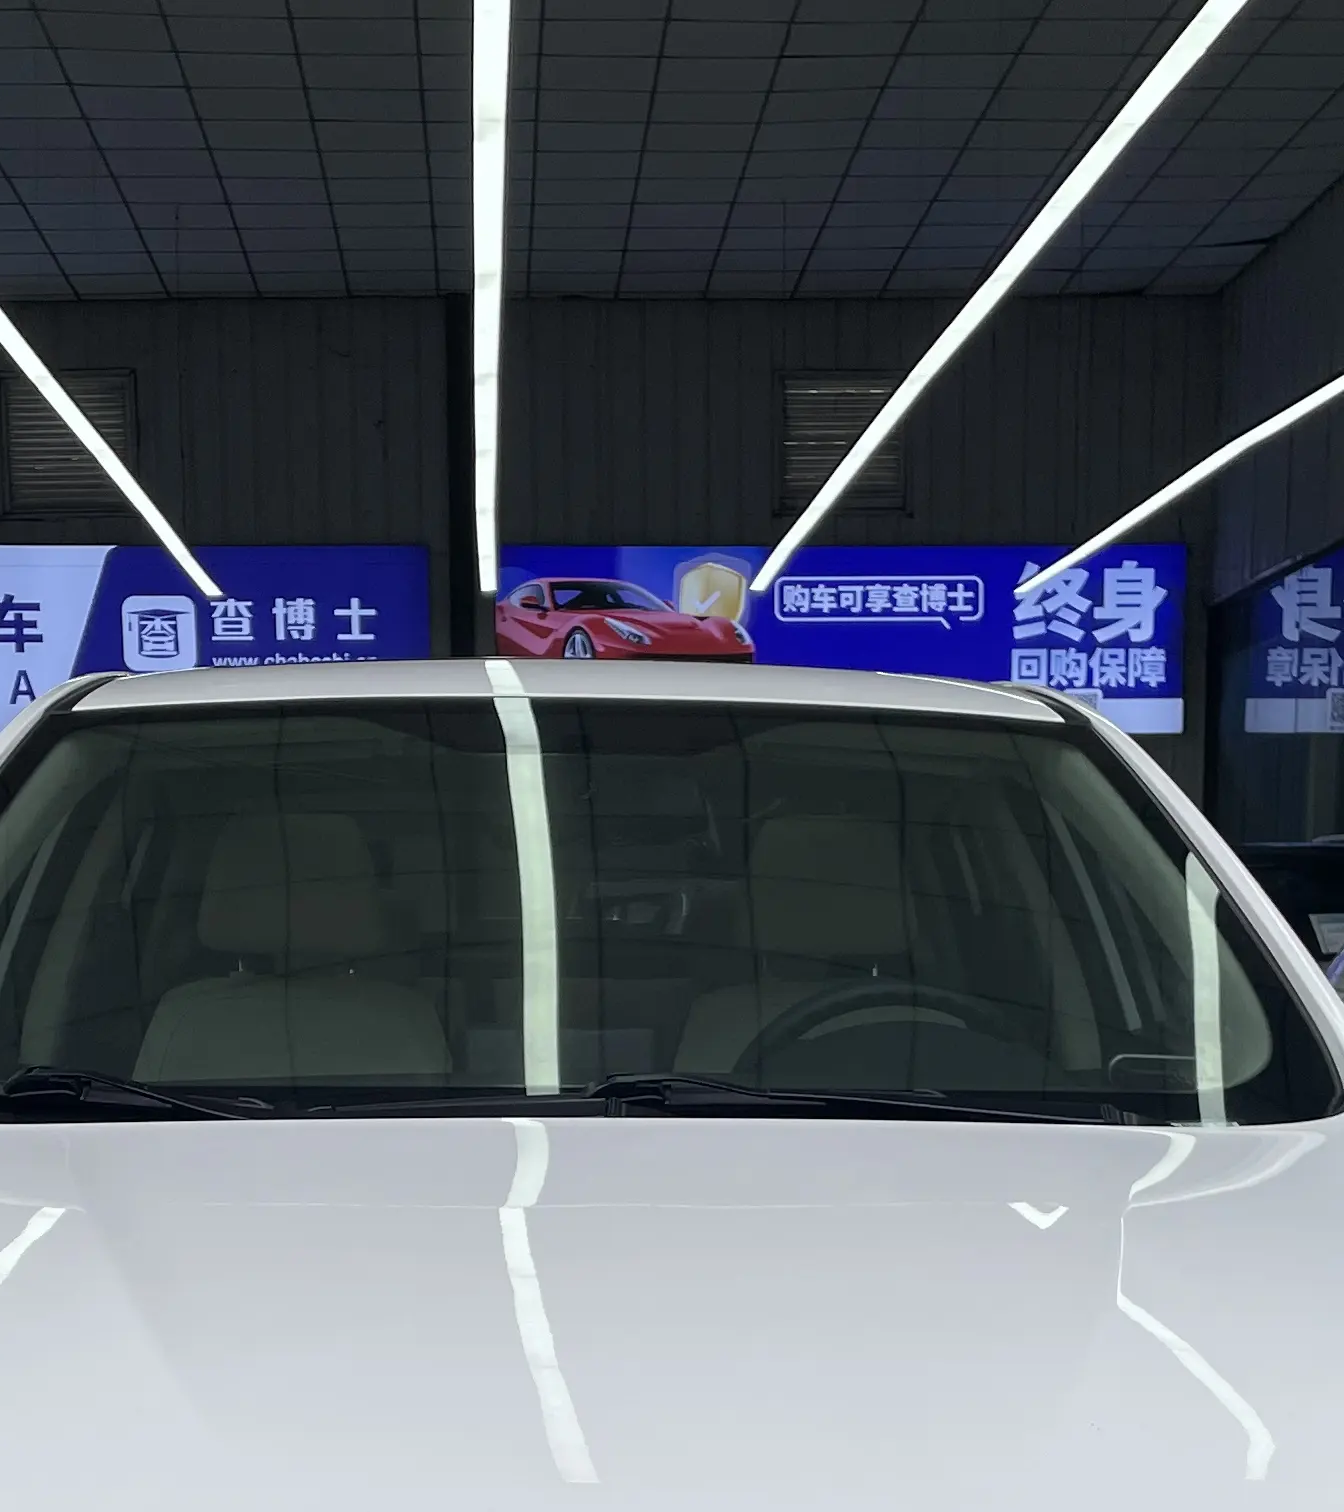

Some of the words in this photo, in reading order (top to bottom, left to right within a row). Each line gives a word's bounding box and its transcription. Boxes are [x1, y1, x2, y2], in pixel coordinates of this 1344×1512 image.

[210, 597, 379, 643] 查博士
[782, 583, 975, 616] 购车可享查博士
[1011, 561, 1168, 645] 终身
[1010, 646, 1167, 687] 回购保障
